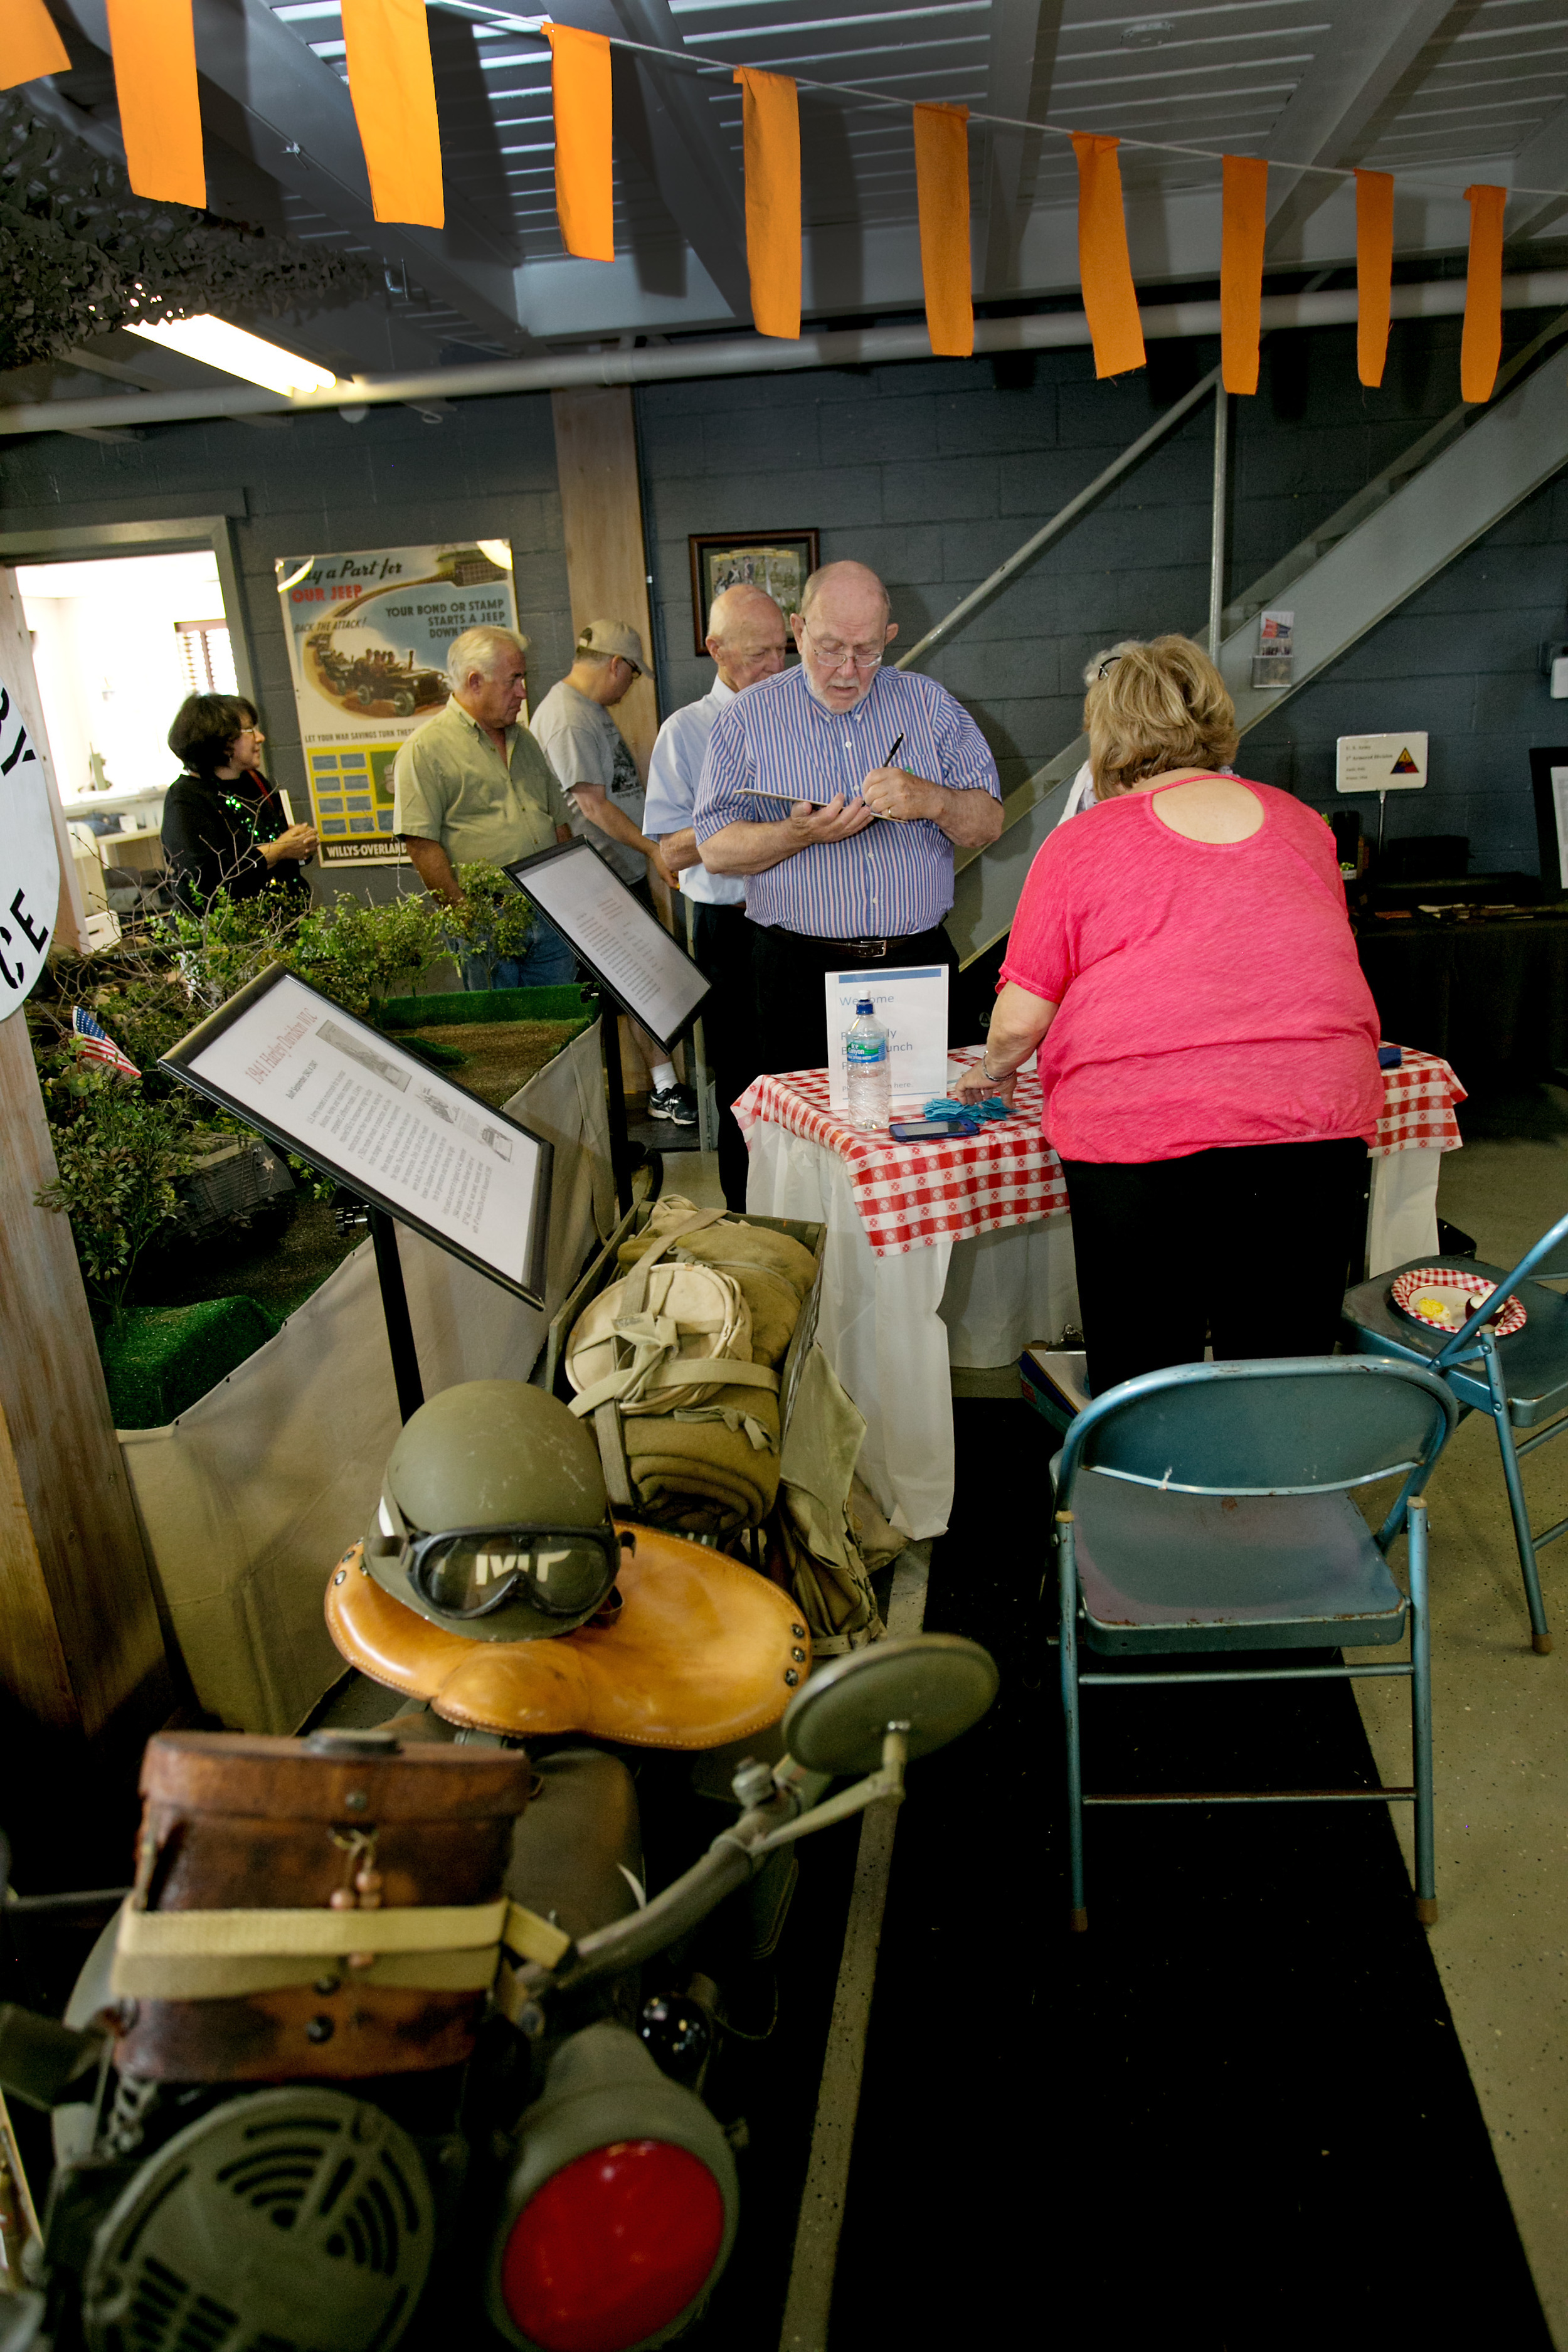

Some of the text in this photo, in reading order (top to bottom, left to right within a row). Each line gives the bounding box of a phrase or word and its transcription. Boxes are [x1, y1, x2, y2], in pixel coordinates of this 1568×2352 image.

[326, 570, 336, 579] a
[340, 560, 378, 578] Part
[379, 558, 402, 580] for
[292, 585, 363, 603] OUR JEEP
[386, 599, 504, 617] YOUR BOND OR STAMP
[428, 612, 506, 626] STARTS A JEEP
[430, 628, 458, 638] DOWN
[305, 734, 315, 743] LET
[317, 733, 334, 741] YOUR
[351, 731, 377, 739] SAVINGS
[245, 1060, 271, 1084] 1941
[259, 1043, 292, 1068] Harley
[277, 1022, 308, 1049] Davidson
[291, 1076, 307, 1093] September
